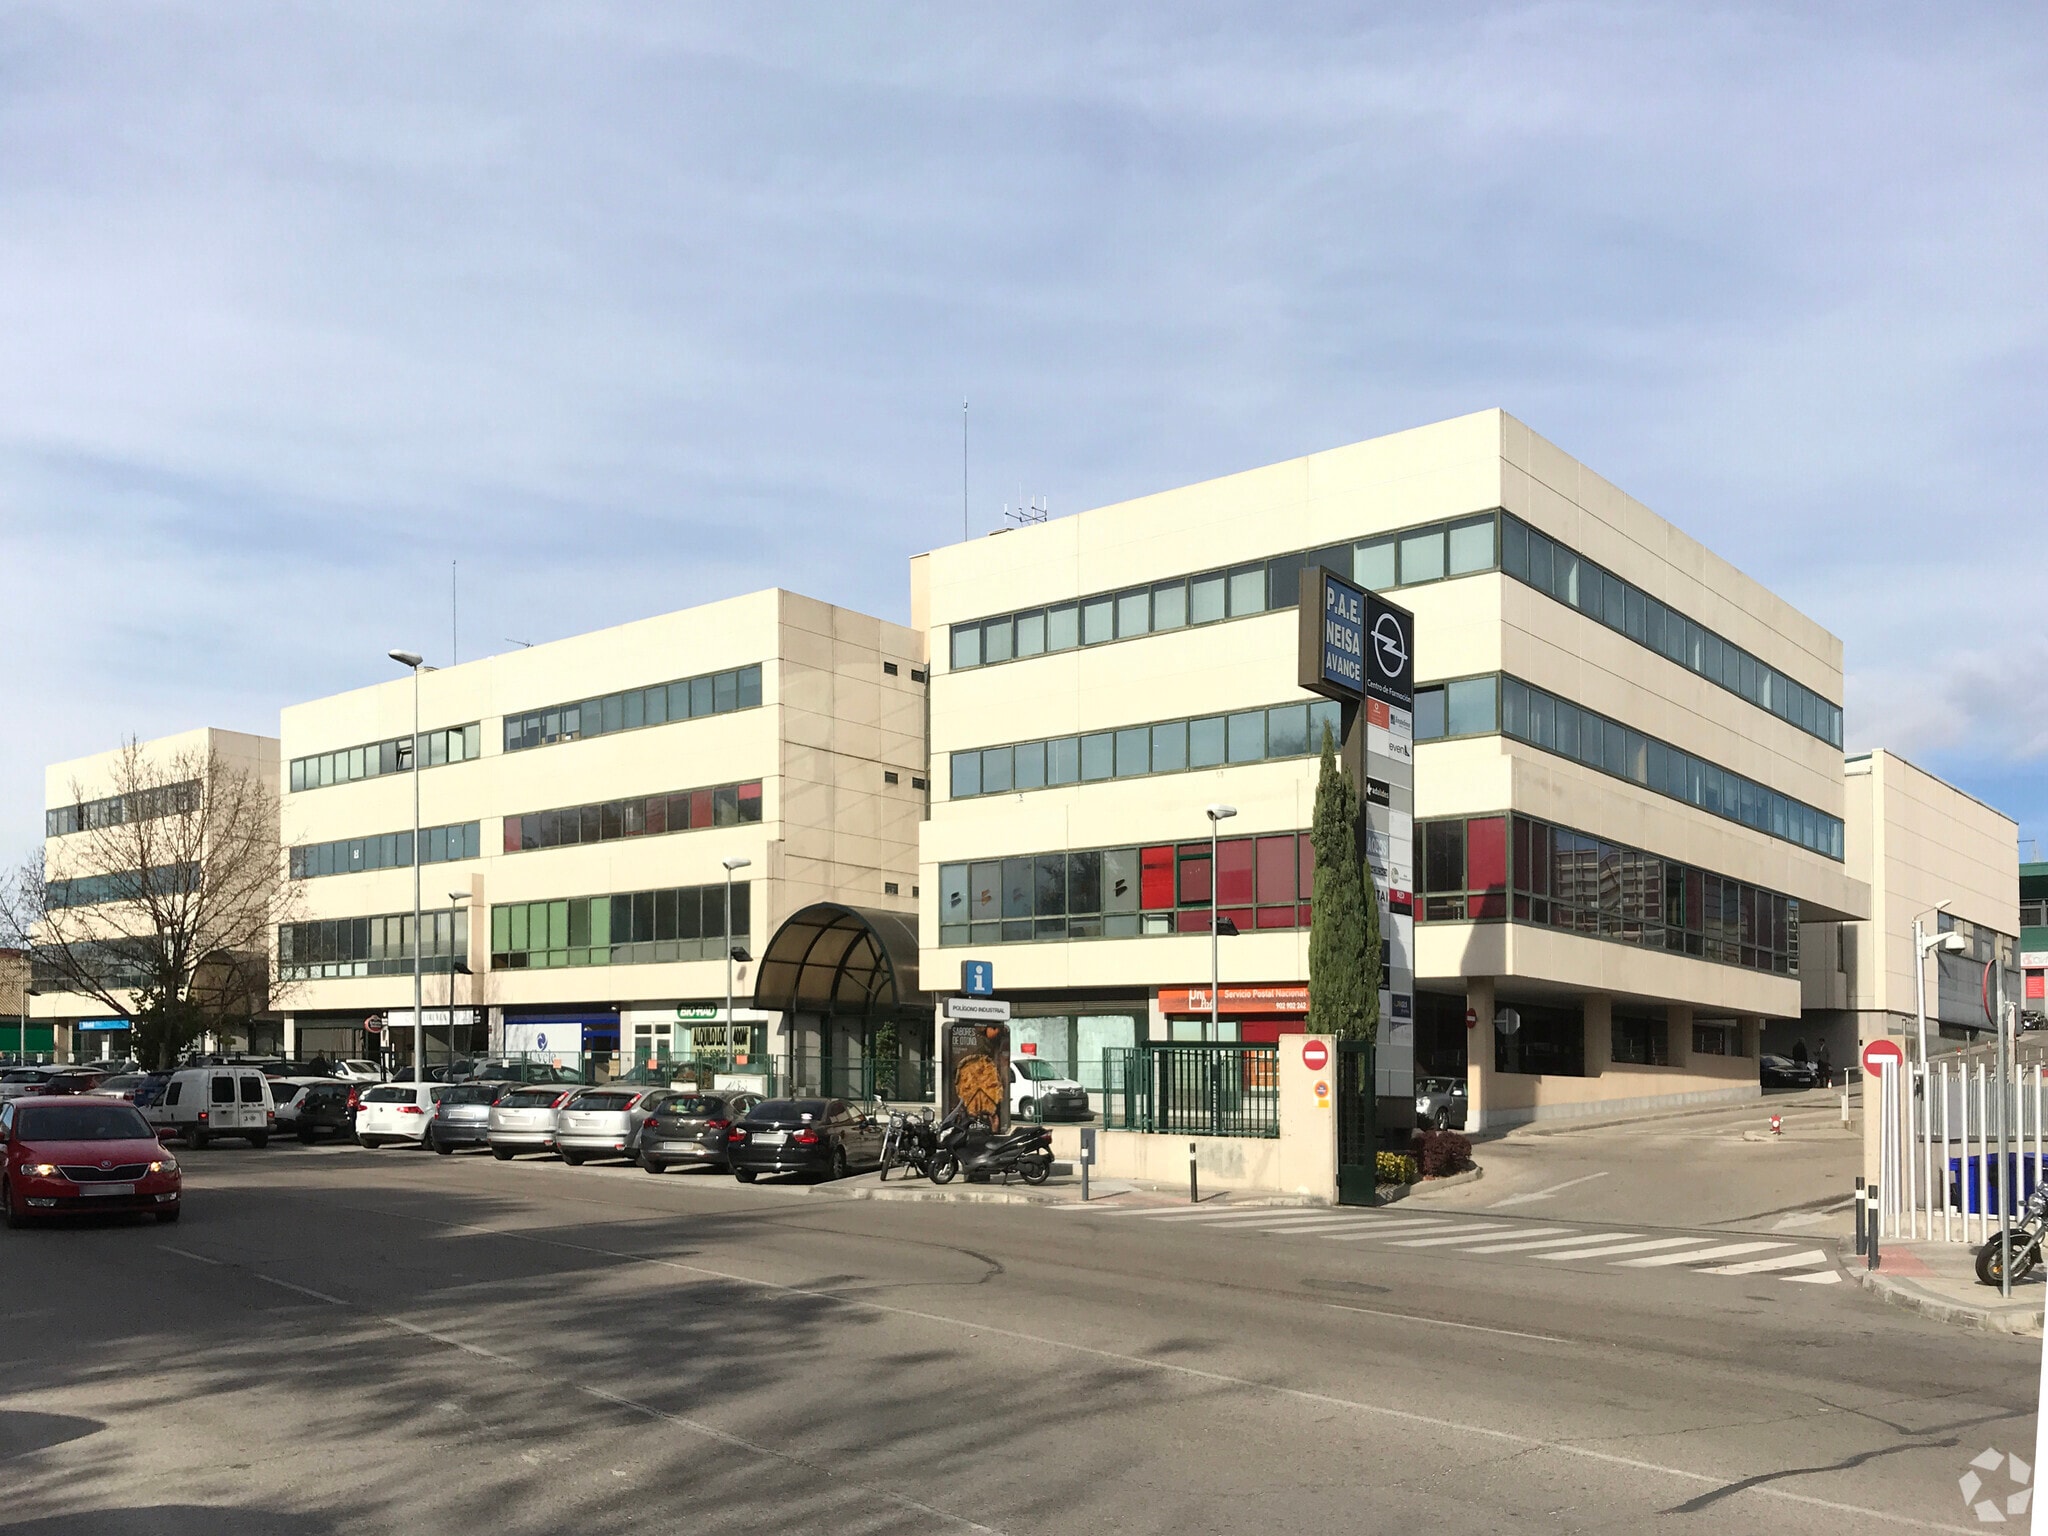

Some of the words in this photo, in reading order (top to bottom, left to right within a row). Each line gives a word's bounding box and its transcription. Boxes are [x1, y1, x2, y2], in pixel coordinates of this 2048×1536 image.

[1326, 586, 1361, 625] P.A.E.
[1326, 620, 1361, 657] NEISA
[1326, 652, 1361, 682] AVANCE
[1367, 678, 1382, 692] Centro
[1382, 684, 1389, 695] de
[1388, 687, 1412, 704] Formación
[1224, 989, 1251, 999] Servicio
[1252, 989, 1274, 998] Postal
[1275, 988, 1307, 998] Nacional
[952, 1005, 978, 1013] POLÍGONO
[978, 1006, 1006, 1014] INDUSTRIAL
[1275, 1002, 1285, 1010] 902
[1286, 1002, 1296, 1010] 902
[1296, 1002, 1307, 1010] 242
[693, 1027, 716, 1048] ALQUILO
[952, 1026, 977, 1036] SABORES
[952, 1036, 960, 1045] DE
